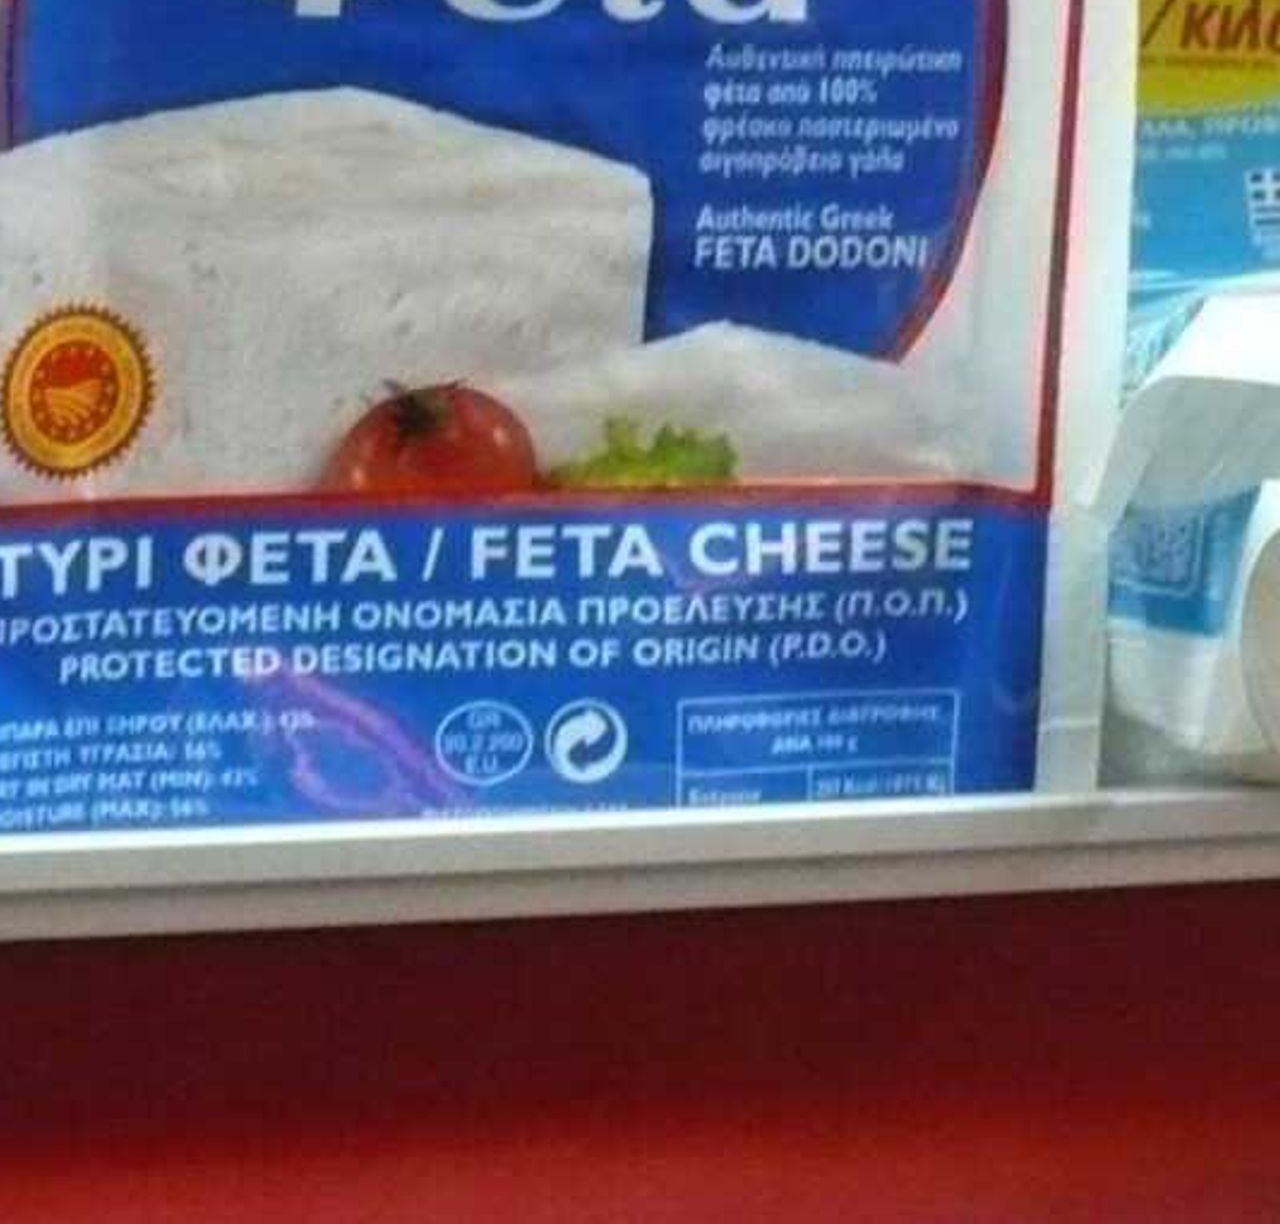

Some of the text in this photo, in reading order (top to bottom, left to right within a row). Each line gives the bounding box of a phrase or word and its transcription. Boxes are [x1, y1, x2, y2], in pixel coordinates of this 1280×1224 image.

[818, 76, 879, 105] 100%
[695, 203, 895, 232] Authentic Greek
[693, 234, 928, 270] FETA DODONI
[182, 528, 398, 587] ΦΕΤΑ
[421, 527, 444, 583] /
[470, 524, 665, 581] FETA
[688, 518, 975, 577] CHEESE
[352, 594, 568, 634] ΟΝΟΜΑΣΙΑ
[578, 590, 827, 628] ΠΡΟΕΛΕΥΣΗΣ
[834, 588, 970, 624] (Π.Ο.Π.)
[59, 630, 888, 686] PROTECTED DESIGNATION OF ORIGIN (P.D.O.)
